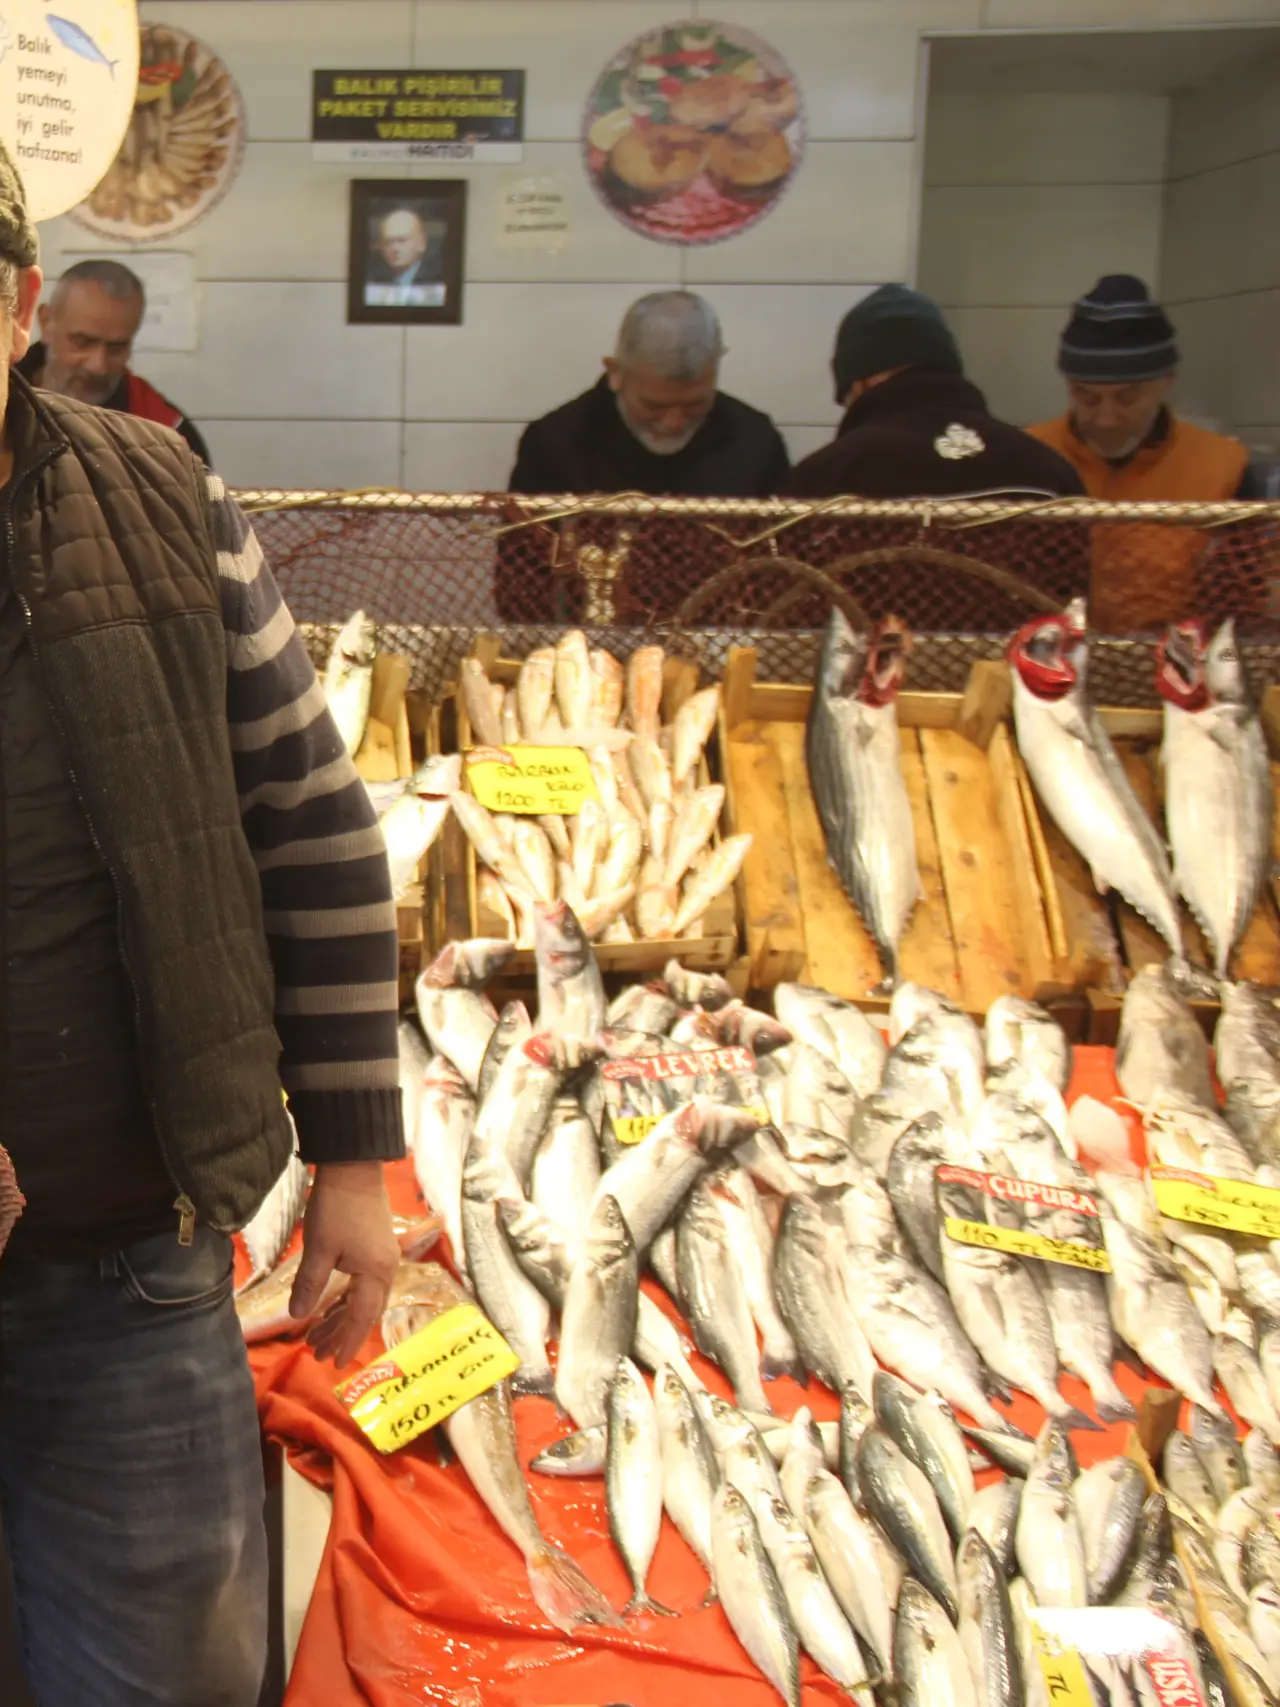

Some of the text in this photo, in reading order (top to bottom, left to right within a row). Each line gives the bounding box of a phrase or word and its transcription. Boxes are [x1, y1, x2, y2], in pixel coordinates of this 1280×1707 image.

[17, 33, 52, 54] Balık
[17, 65, 68, 88] yemeyi
[333, 76, 503, 98] BALIK PİŞİRİLİR
[17, 92, 77, 114] unutma,
[319, 100, 388, 117] PAKET
[17, 112, 75, 139] iyi gelir
[377, 121, 457, 139] VARDIR
[495, 791, 536, 807] 1200
[651, 1047, 753, 1078] LEVREK
[988, 1175, 1098, 1213] ÇUPURA
[963, 1223, 999, 1246] 110
[389, 1402, 431, 1439] 150
